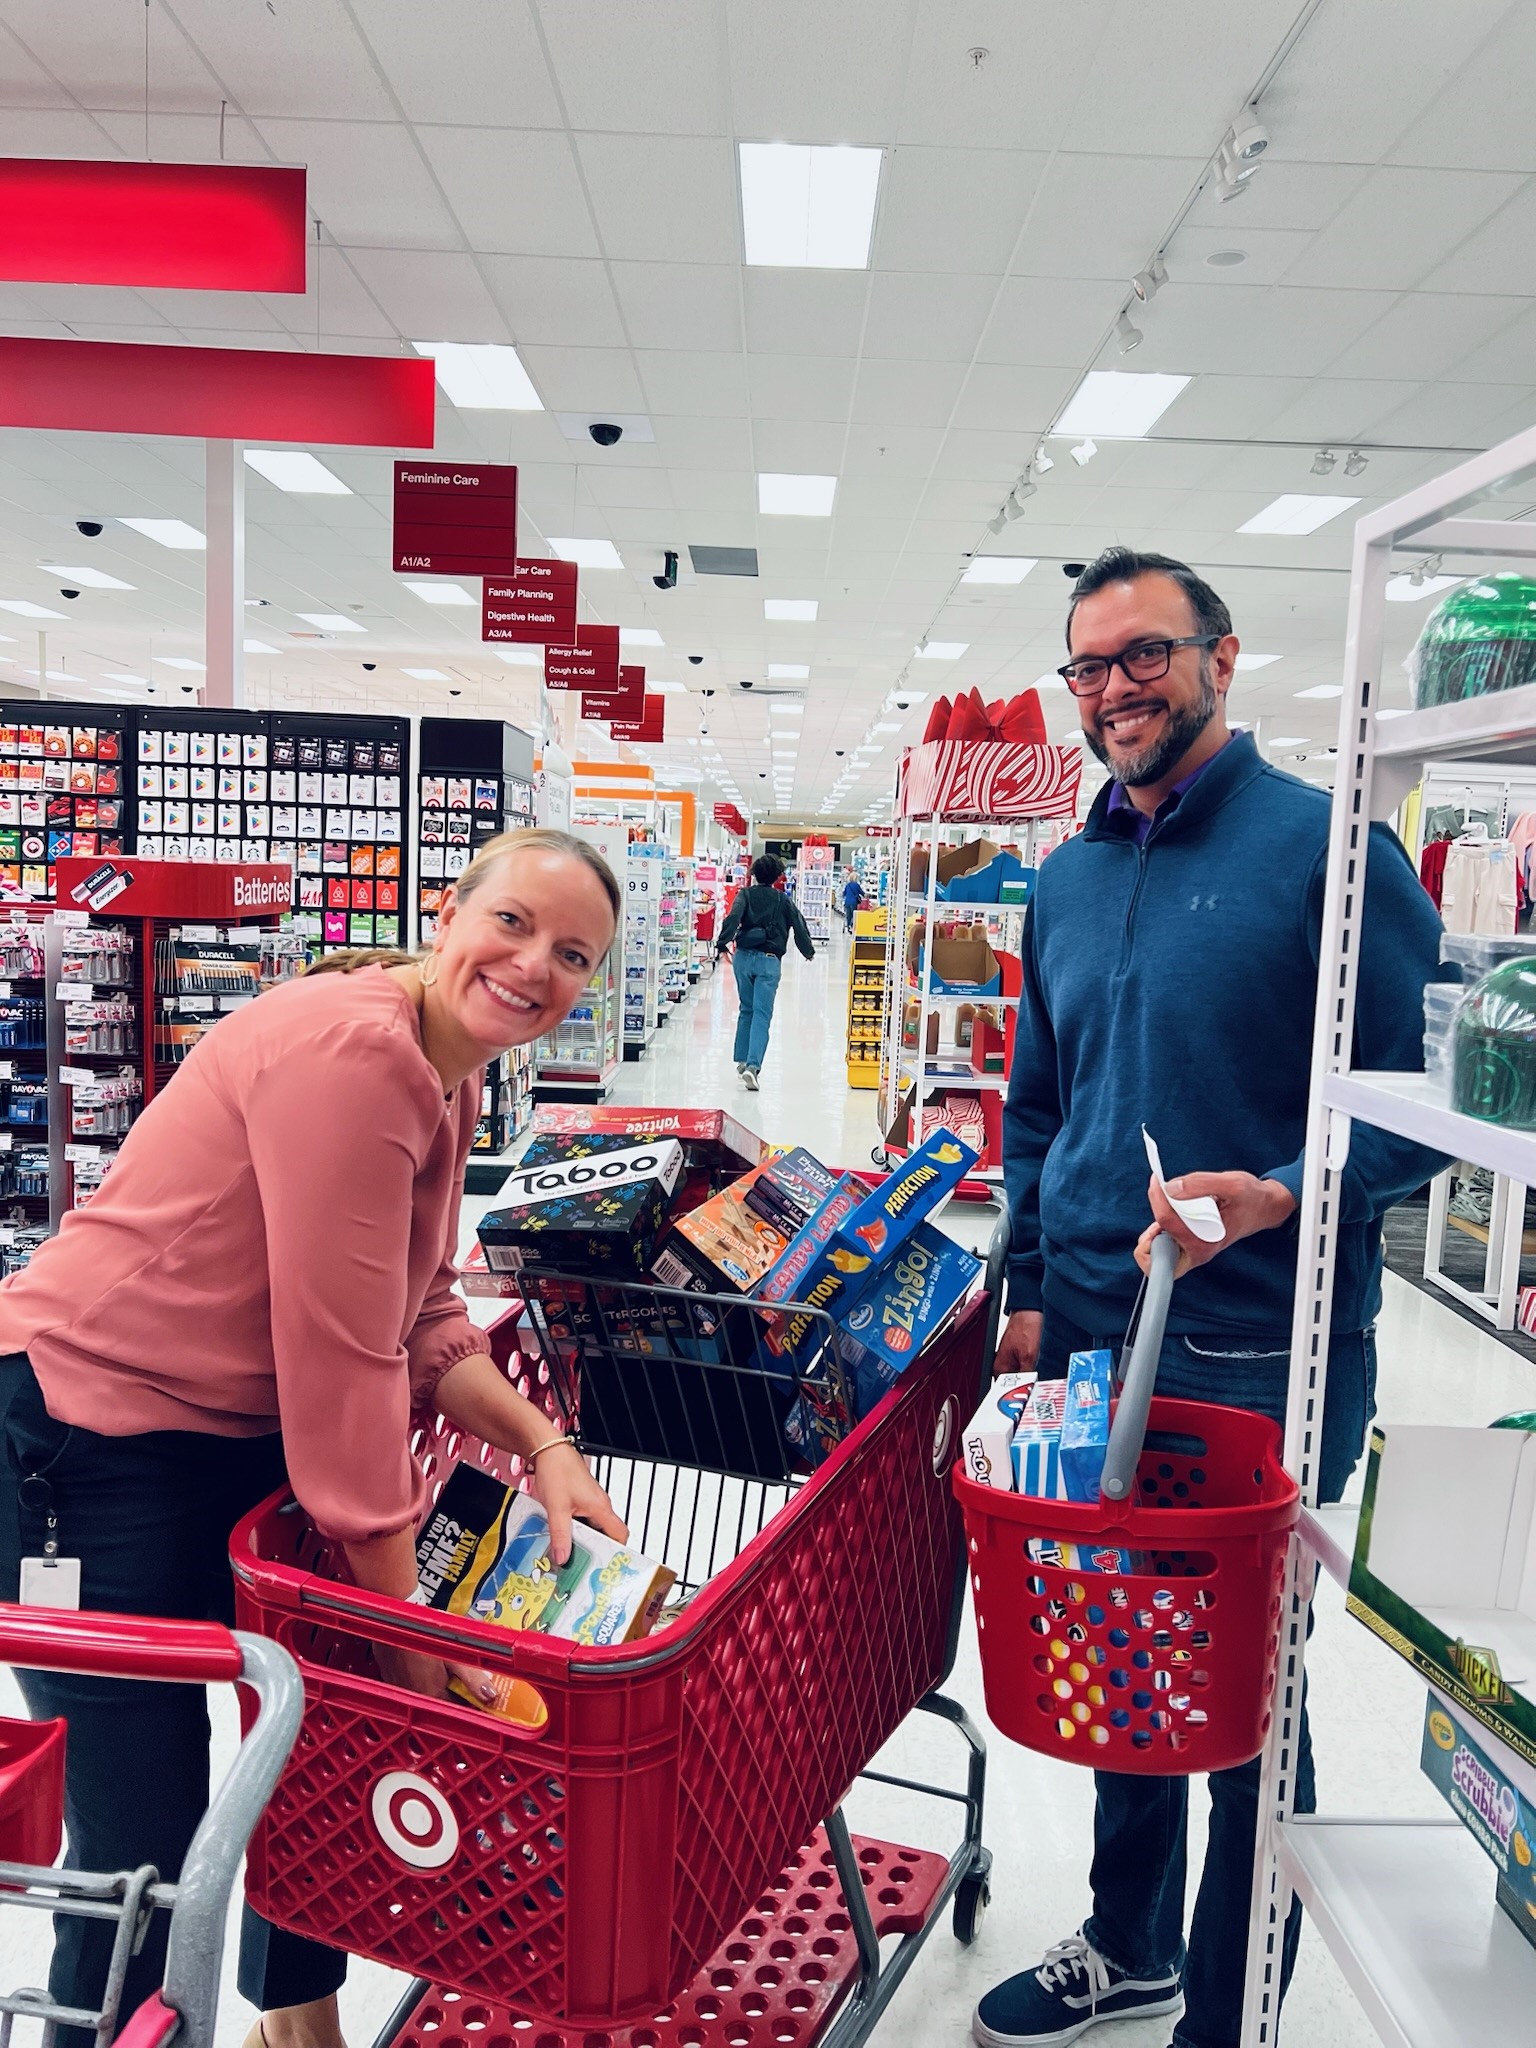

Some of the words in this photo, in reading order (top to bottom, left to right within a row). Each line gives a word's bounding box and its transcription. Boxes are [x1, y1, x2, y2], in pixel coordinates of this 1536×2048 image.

[400, 472, 450, 485] Feminine
[453, 474, 480, 486] Care
[400, 556, 431, 568] A1/A2
[516, 566, 530, 576] Ear
[530, 567, 552, 576] Care
[488, 588, 516, 600] Family
[517, 589, 554, 601] Planning
[487, 611, 526, 622] Digestive
[527, 612, 555, 623] Health
[488, 630, 512, 638] A3/A4
[548, 648, 573, 657] Allergy
[548, 666, 571, 676] Cough
[578, 667, 596, 675] Cold
[584, 699, 610, 707] Vitamins
[87, 868, 112, 889] DURACELL
[95, 883, 120, 905] Energizer
[234, 876, 290, 906] Batteries
[198, 951, 235, 960] DURACELL
[12, 1084, 48, 1093] RAYOVAC
[626, 1116, 682, 1134] Yahtzee
[511, 1156, 658, 1194] Taboo
[664, 1150, 682, 1182] Taboo
[798, 1156, 825, 1181] Phase
[884, 1165, 939, 1218] PERFECTION
[811, 1195, 850, 1242] LAND
[764, 1237, 816, 1299] CANDY
[492, 1279, 548, 1292] Yahze
[883, 1240, 939, 1332] Zingo!
[781, 1274, 843, 1354] PERFETION
[918, 1298, 932, 1322] BINGO
[968, 1437, 992, 1488] TROU
[417, 1540, 434, 1561] DO
[426, 1513, 448, 1540] YOU
[444, 1528, 477, 1583] FAMILY
[1422, 1660, 1452, 1690] CANDY
[1454, 1686, 1494, 1726] BROOMS
[1460, 1747, 1496, 1797] SCRIBBLE
[1454, 1754, 1508, 1843] Scrubbie
